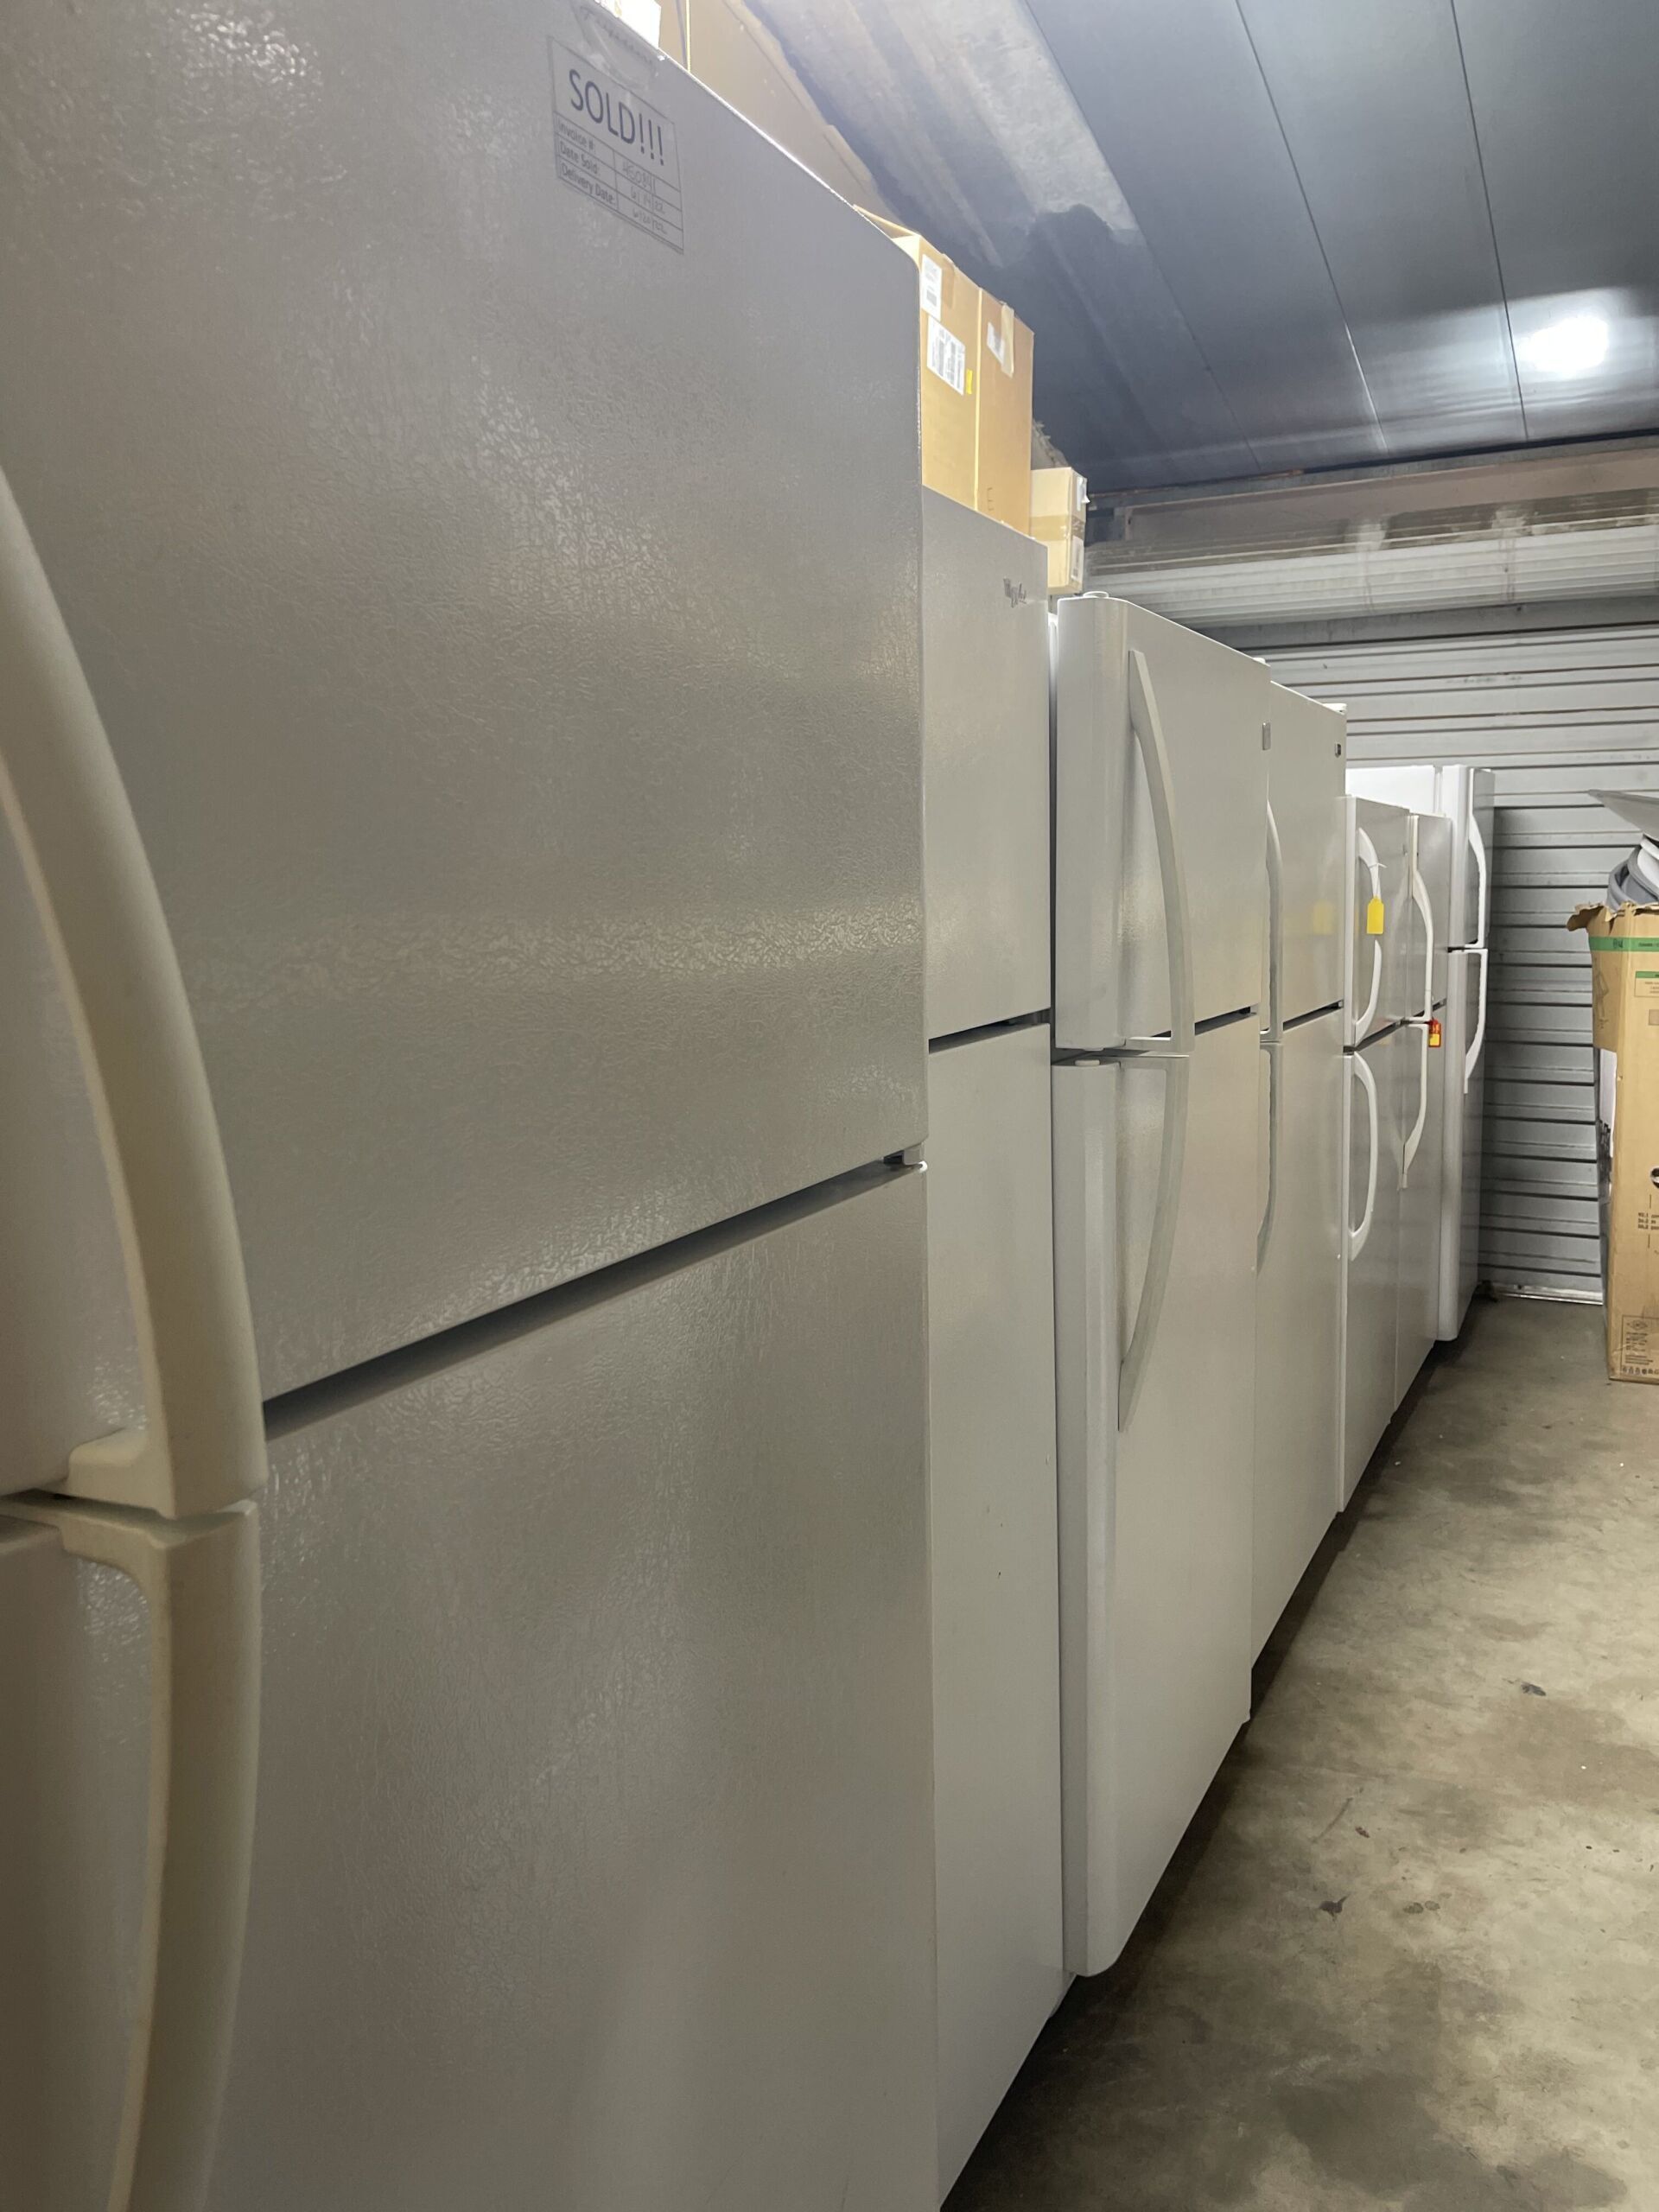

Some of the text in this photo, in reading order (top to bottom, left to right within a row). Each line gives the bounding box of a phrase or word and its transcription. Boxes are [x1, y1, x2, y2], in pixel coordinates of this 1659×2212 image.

[557, 118, 587, 148] Invoice
[569, 69, 664, 166] SOLD!!!
[560, 140, 578, 163] Date
[562, 162, 593, 194] Delivery
